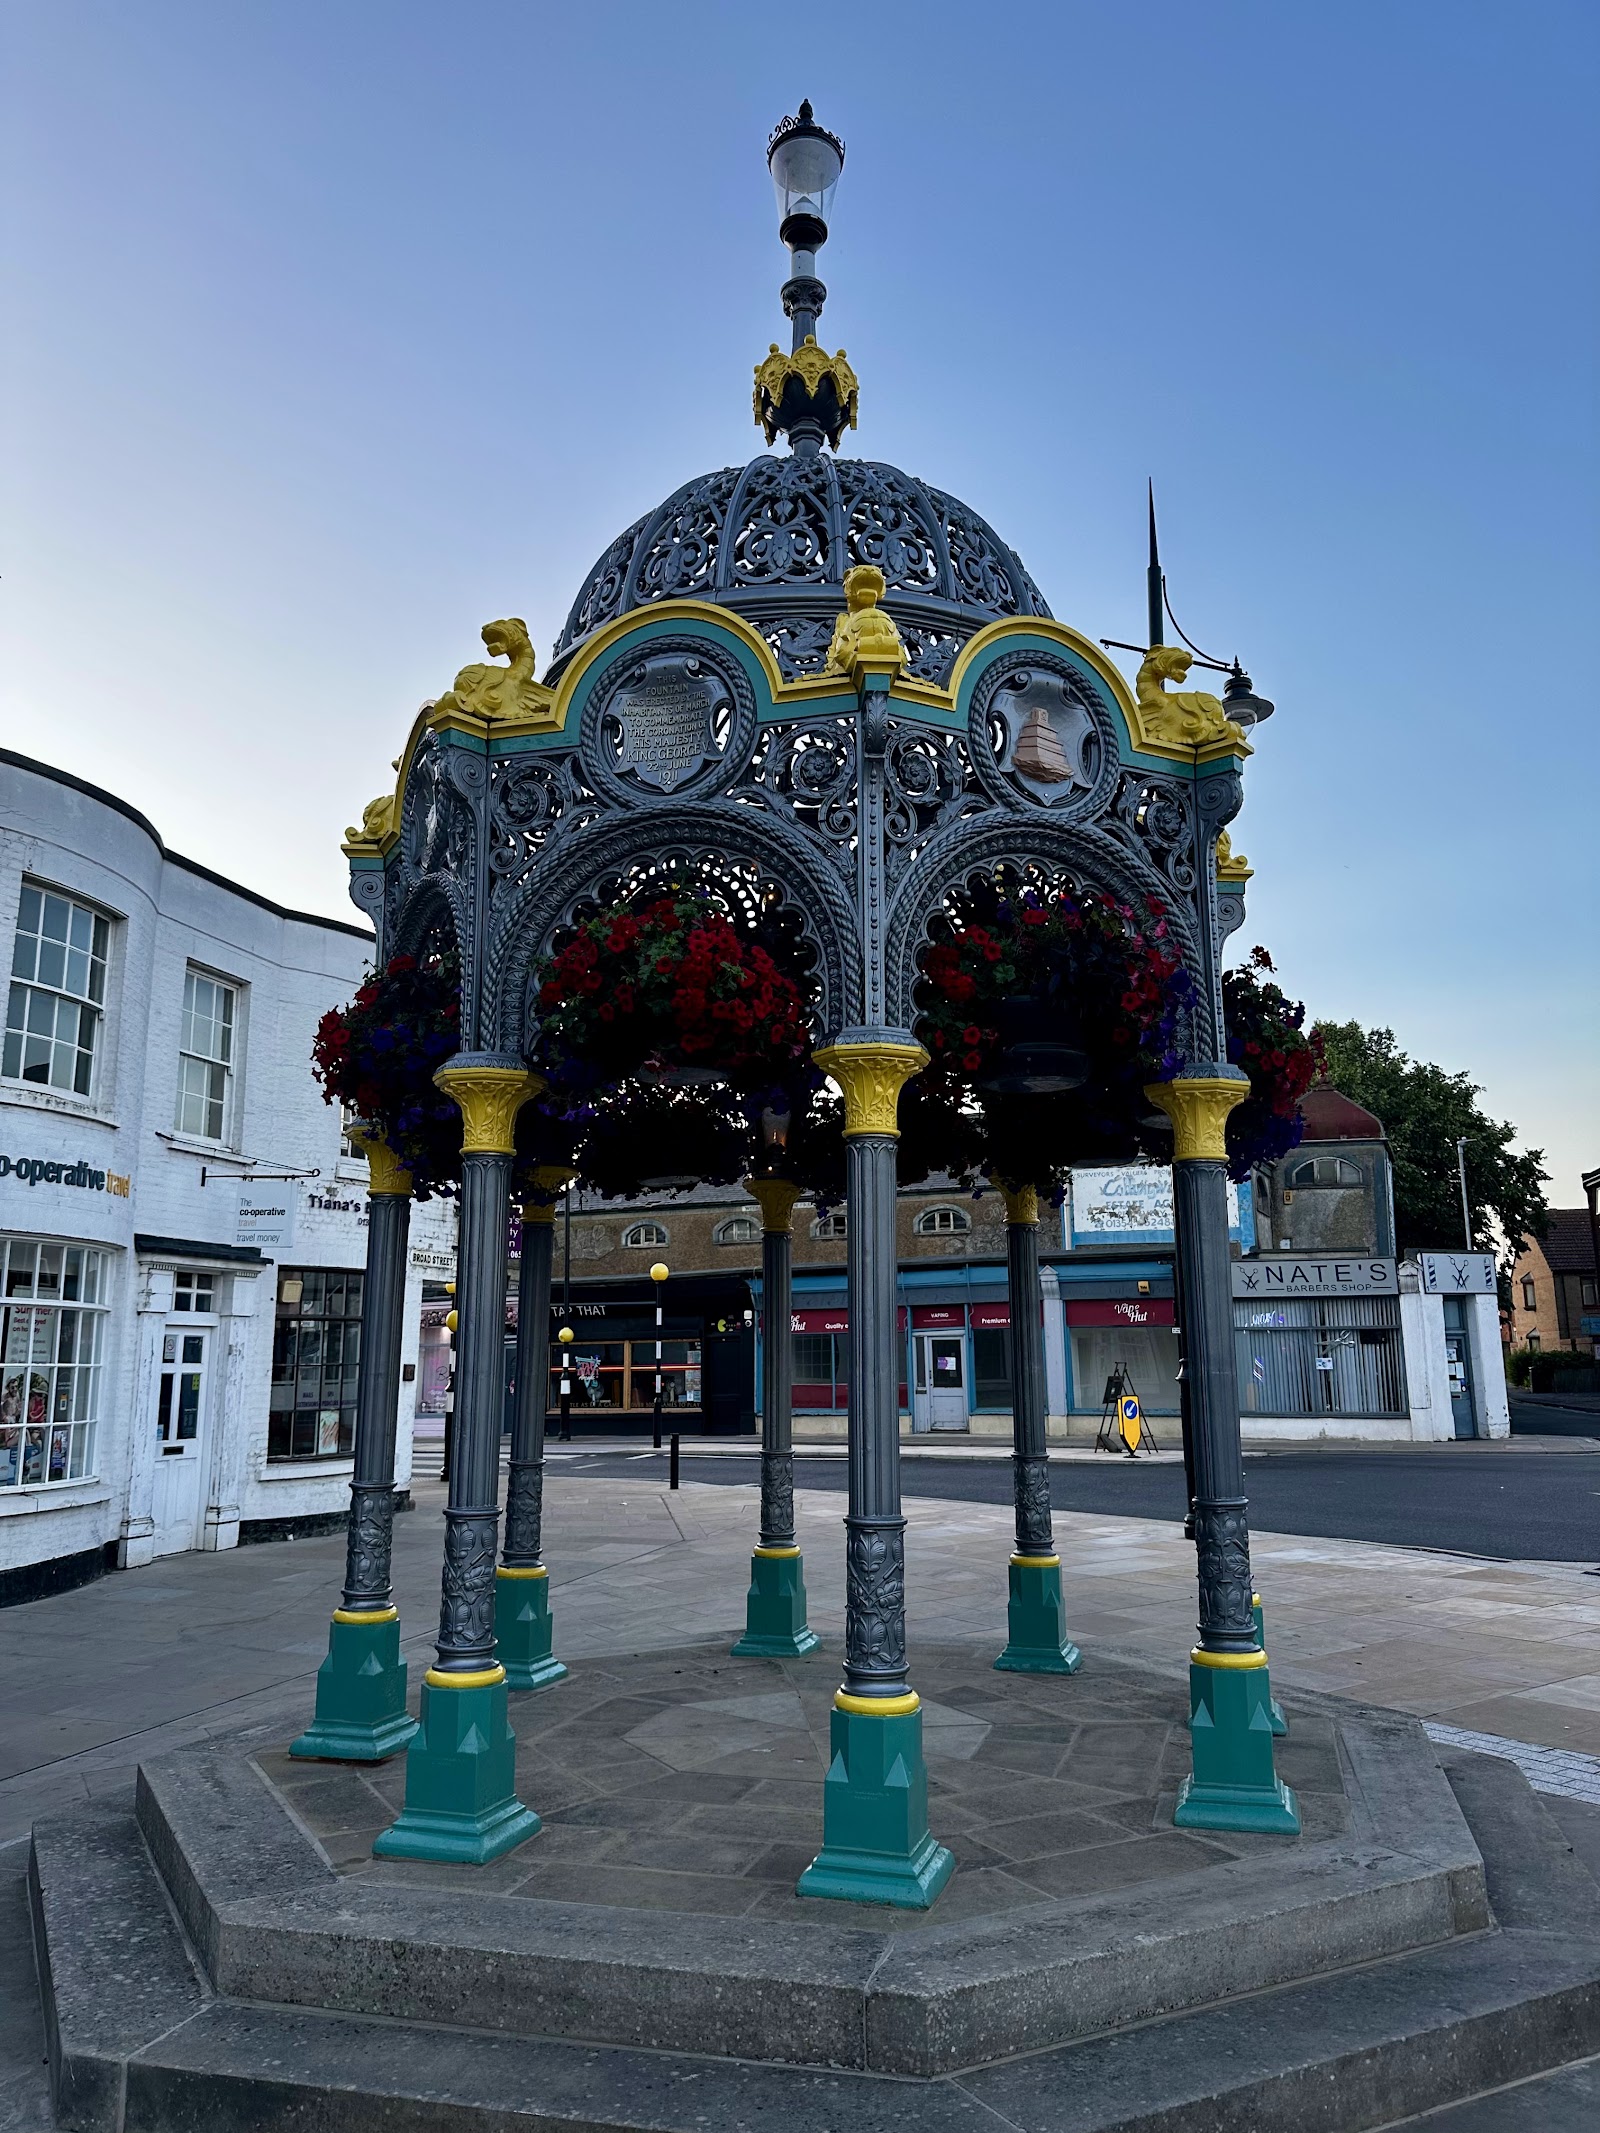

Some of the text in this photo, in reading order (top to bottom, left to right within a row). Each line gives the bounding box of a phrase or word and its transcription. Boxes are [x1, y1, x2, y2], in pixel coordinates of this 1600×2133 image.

[656, 675, 677, 684] THIS
[645, 683, 689, 696] FOUNTAIN
[626, 690, 706, 707] WAS ERECTED BY THE
[621, 698, 711, 717] INHABITANTS OF MARCH
[629, 711, 704, 728] TO COMMEMORATE
[628, 720, 708, 738] THE CORONATION OF
[633, 732, 702, 749] HIS MAJESTY
[627, 749, 656, 762] KING
[658, 743, 702, 760] GEORGE
[667, 758, 692, 770] JUNE
[658, 770, 679, 785] 1911
[106, 1168, 131, 1198] travel
[240, 1197, 252, 1207] The
[308, 1194, 361, 1212] Tiana's
[239, 1207, 286, 1217] co-operative
[238, 1219, 257, 1227] travel
[236, 1233, 280, 1244] travel money
[412, 1252, 453, 1266] BROAD STREET
[1265, 1263, 1388, 1284] NATE'S
[1286, 1283, 1373, 1293] BARBERS SHOP
[575, 1304, 606, 1316] THAT
[1129, 1311, 1148, 1323] Hut
[824, 1322, 845, 1330] Quality
